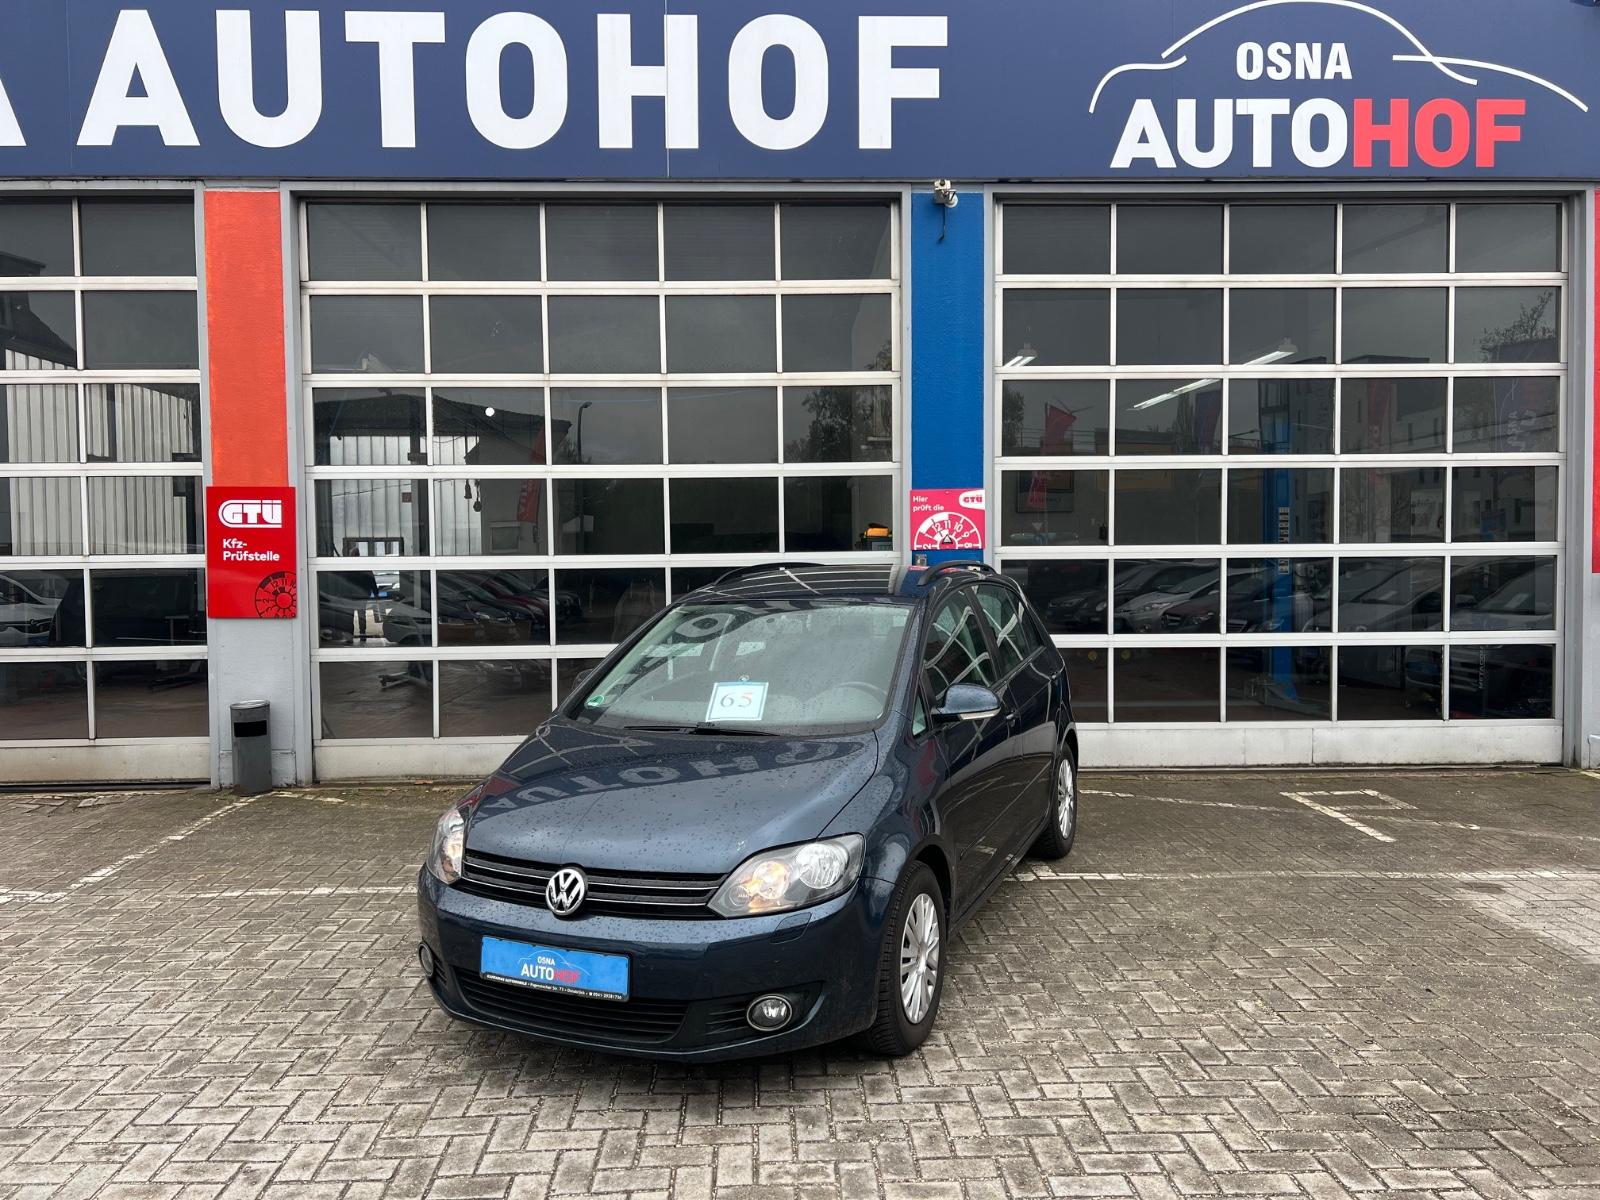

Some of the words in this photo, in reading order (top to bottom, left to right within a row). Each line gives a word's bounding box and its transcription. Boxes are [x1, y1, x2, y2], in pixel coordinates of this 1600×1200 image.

[1236, 41, 1352, 80] OSNA
[76, 9, 949, 150] AUTOHOF
[1110, 97, 1526, 168] AUTOHOF
[912, 495, 929, 503] Hier
[218, 499, 282, 528] GTÜ
[912, 504, 932, 512] prüft
[222, 538, 248, 549] Kfz-
[222, 551, 281, 562] Prüfstelle
[719, 691, 754, 708] 65
[537, 956, 556, 966] OSNA
[520, 963, 582, 984] AUTOHOF
